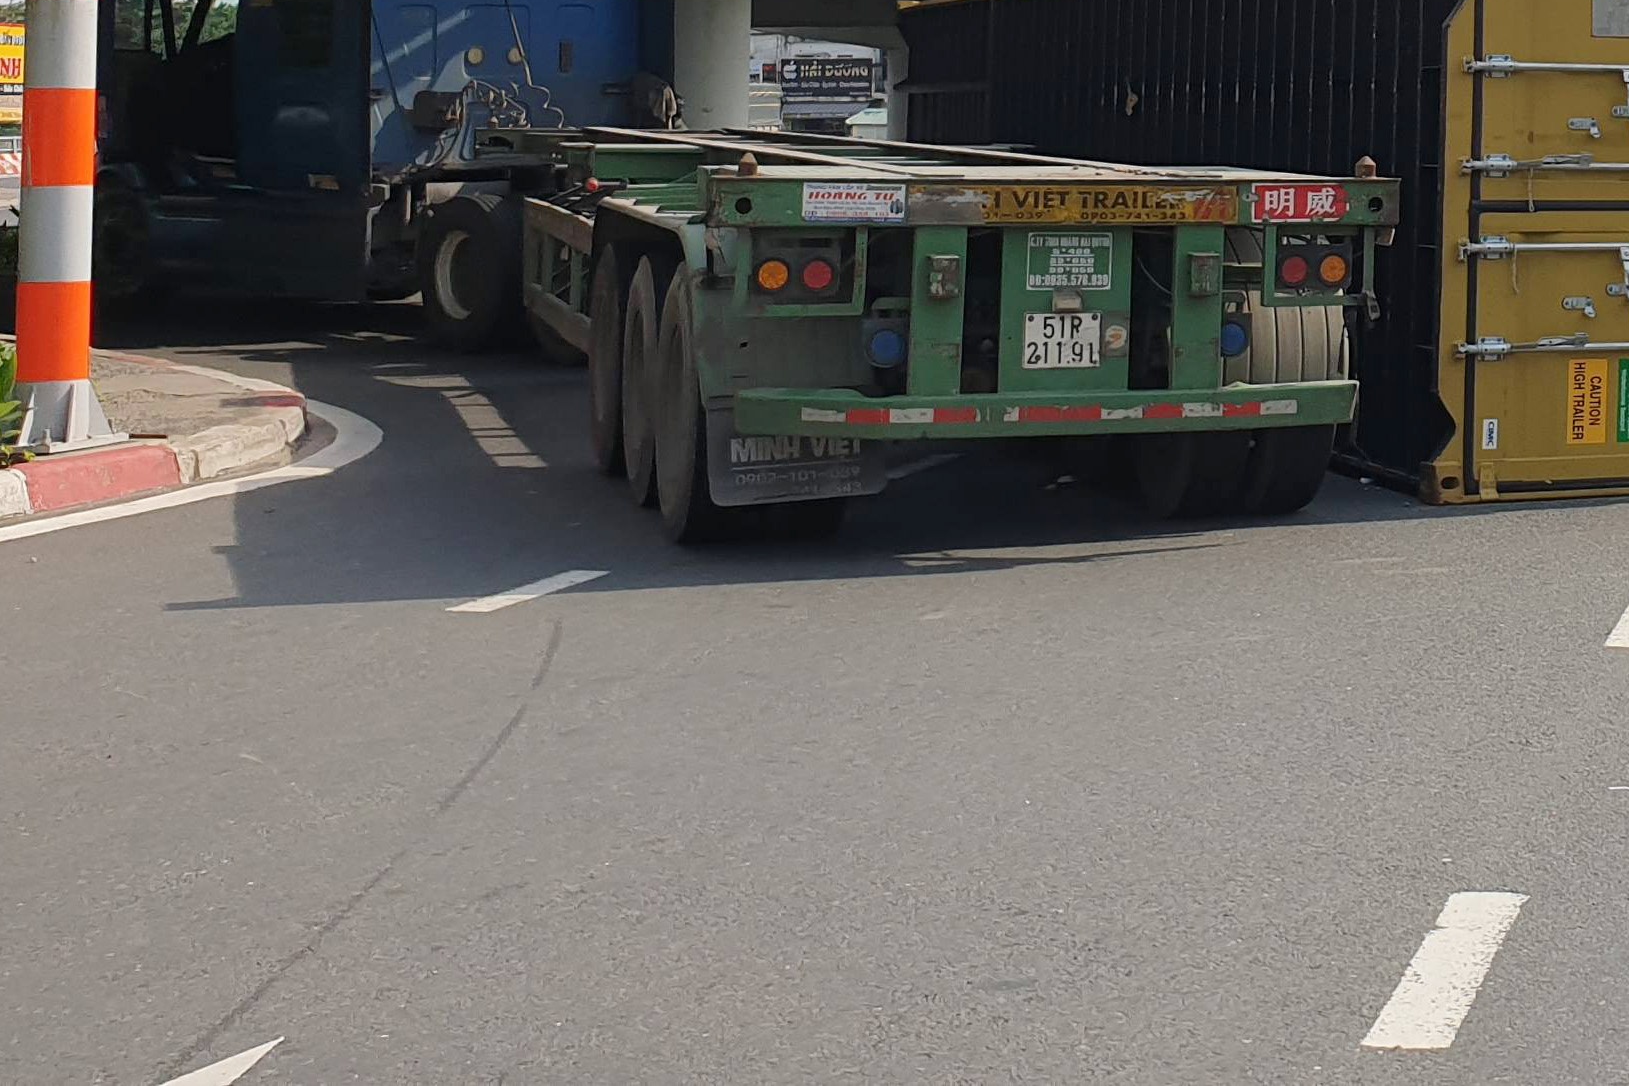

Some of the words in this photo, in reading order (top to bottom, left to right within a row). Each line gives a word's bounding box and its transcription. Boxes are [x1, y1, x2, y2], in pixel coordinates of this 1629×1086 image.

[1264, 188, 1336, 216] 明威
[1043, 315, 1083, 339] 51R
[1573, 362, 1586, 390] HIGH
[1589, 375, 1602, 426] CAUTION
[1572, 393, 1585, 440] TRAILER
